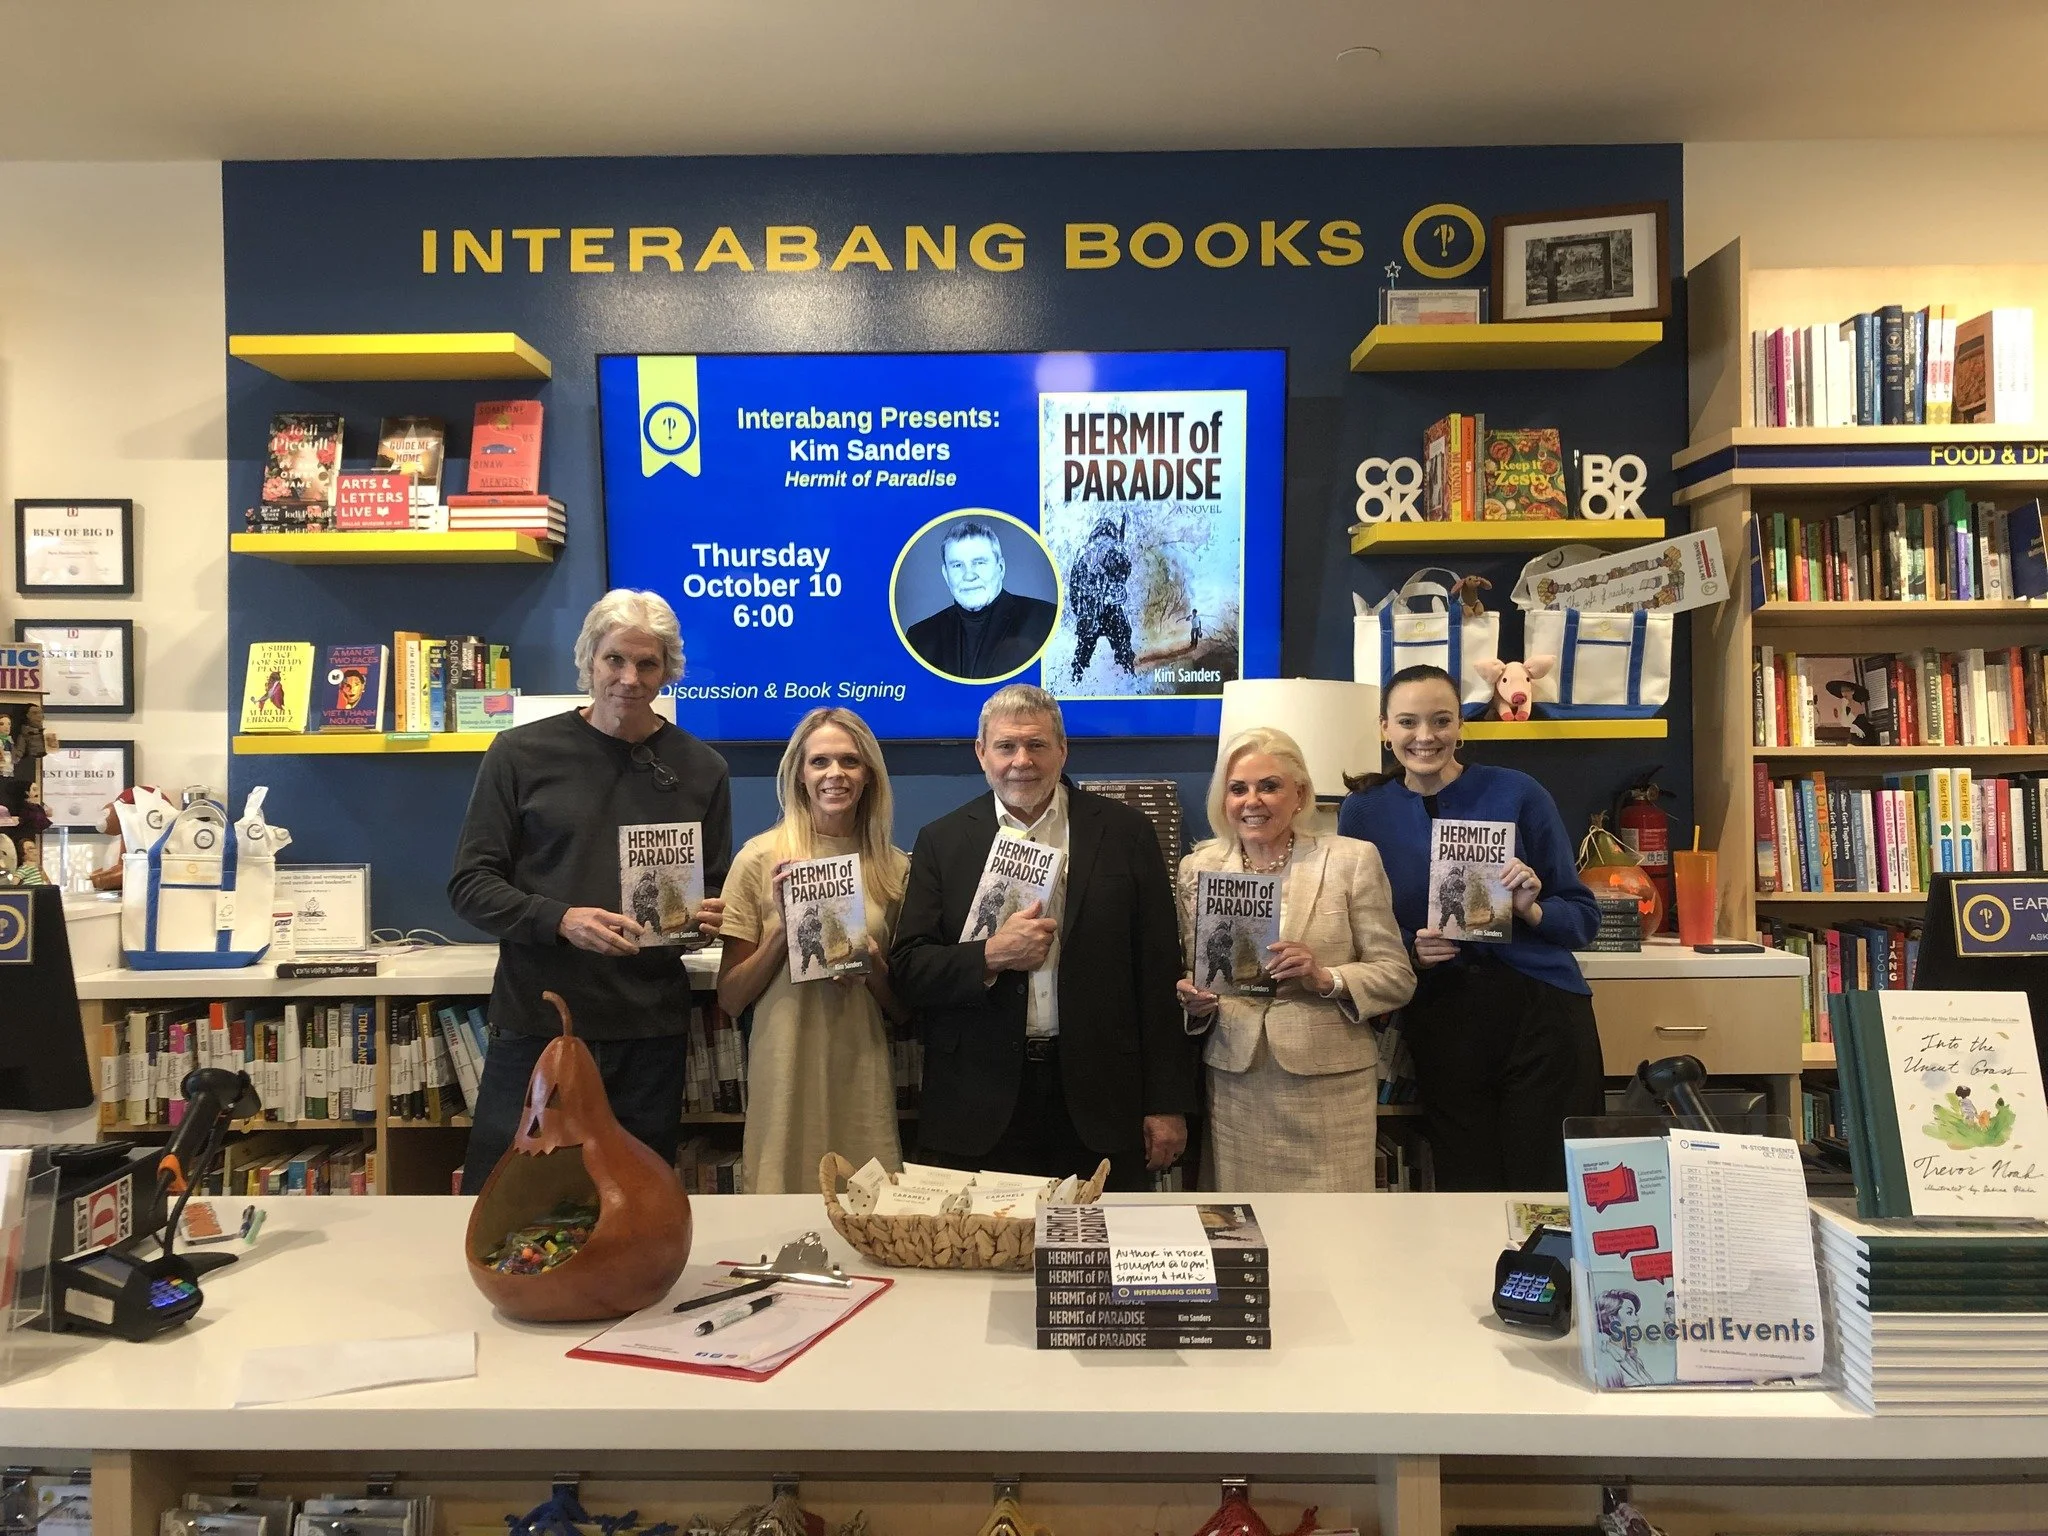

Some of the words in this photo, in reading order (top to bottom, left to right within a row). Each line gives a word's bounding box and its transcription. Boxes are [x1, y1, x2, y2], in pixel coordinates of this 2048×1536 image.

[422, 222, 1026, 273] INTERABANG
[1065, 219, 1365, 270] BOOKS
[737, 407, 872, 433] Interabang
[881, 406, 1000, 428] Presents:
[1064, 411, 1184, 455] HERMIT
[1189, 411, 1223, 454] of
[396, 453, 421, 463] HOME
[790, 439, 839, 461] Kim
[847, 438, 951, 461] Sanders
[1930, 445, 1996, 465] FOOD
[2001, 445, 2017, 465] &
[1500, 460, 1530, 473] Keep
[341, 478, 377, 489] ARTS
[382, 478, 391, 489] &
[785, 470, 847, 487] Hermit
[852, 469, 872, 487] of
[875, 469, 957, 487] Paradise
[1063, 457, 1222, 502] PARADISE
[1494, 470, 1551, 487] Zesty
[341, 492, 404, 504] LETTERS
[341, 506, 372, 517] LIVE
[1175, 505, 1183, 514] A
[1185, 504, 1222, 515] NOVEL
[33, 528, 61, 537] BEST
[64, 528, 79, 537] OF
[83, 528, 102, 537] BIG
[106, 528, 114, 537] D
[692, 542, 830, 573] Thursday
[683, 573, 799, 598] October
[808, 573, 842, 597] 10
[733, 603, 794, 628] 6:00
[83, 649, 102, 658] BIG
[106, 650, 114, 658] D
[341, 649, 362, 657] MAN
[351, 656, 379, 664] FACES
[449, 640, 458, 685] SOLENOID
[1154, 668, 1175, 684] Kim
[1178, 668, 1221, 684] Sanders
[764, 683, 778, 699] &
[784, 682, 832, 699] Book
[837, 681, 907, 701] Signing
[344, 709, 376, 717] THANH
[65, 770, 81, 778] OF
[84, 770, 103, 778] BIG
[107, 770, 115, 778] D
[1939, 778, 1948, 798] Start
[1960, 778, 1969, 798] Start
[1987, 786, 1995, 809] SWEET
[1885, 800, 1894, 821] Cool
[1939, 799, 1948, 818] Here
[1960, 799, 1969, 818] Here
[1885, 822, 1894, 844] Food
[1987, 811, 1995, 836] TOOTH
[628, 829, 678, 849] HERMIT
[680, 828, 694, 846] of
[1440, 825, 1490, 844] HERMIT
[1491, 828, 1507, 846] of
[628, 846, 695, 868] PARADISE
[996, 839, 1041, 866] HERMIT
[1039, 853, 1054, 869] of
[1439, 843, 1506, 864] PARADISE
[791, 862, 837, 886] HERMIT
[840, 860, 852, 878] of
[990, 857, 1048, 887] PARADISE
[791, 878, 855, 904] PARADISE
[1207, 878, 1258, 899] HERMIT
[1260, 881, 1275, 900] of
[1206, 897, 1274, 918] PARADISE
[844, 961, 863, 970] Sanders
[1888, 940, 1898, 981] JANG
[358, 1013, 368, 1033] TOM
[443, 1016, 459, 1047] SUPREMAC
[1921, 1033, 1963, 1053] Into
[1969, 1036, 1996, 1053] the
[1904, 1056, 1960, 1074] Uncut
[1970, 1059, 2027, 1076] Grass
[1913, 1154, 1986, 1180] Trevor
[1992, 1159, 2045, 1180] Noah
[892, 1192, 931, 1201] CARAMELS
[985, 1192, 1025, 1200] CARAMELS
[1046, 1215, 1078, 1243] HERMIT
[1048, 1251, 1084, 1265] HERMIT
[1084, 1251, 1095, 1265] of
[1163, 1248, 1173, 1257] in
[1169, 1260, 1178, 1268] @
[1049, 1270, 1084, 1284] HERMIT
[1085, 1270, 1096, 1284] of
[1171, 1272, 1194, 1280] talk
[1050, 1292, 1085, 1305] HERMIT
[1086, 1291, 1097, 1305] of
[1133, 1289, 1184, 1297] INTERABANG
[1186, 1288, 1212, 1296] CHATS
[1049, 1311, 1085, 1325] HERMIT
[1086, 1311, 1096, 1325] of
[1098, 1311, 1146, 1325] PARADISE
[1178, 1314, 1189, 1322] Kim
[1189, 1314, 1212, 1322] Sanders
[1050, 1333, 1085, 1346] HERMIT
[1086, 1333, 1098, 1346] of
[1099, 1333, 1147, 1346] PARADISE
[1609, 1317, 1715, 1349] Special
[1721, 1317, 1816, 1342] Events
